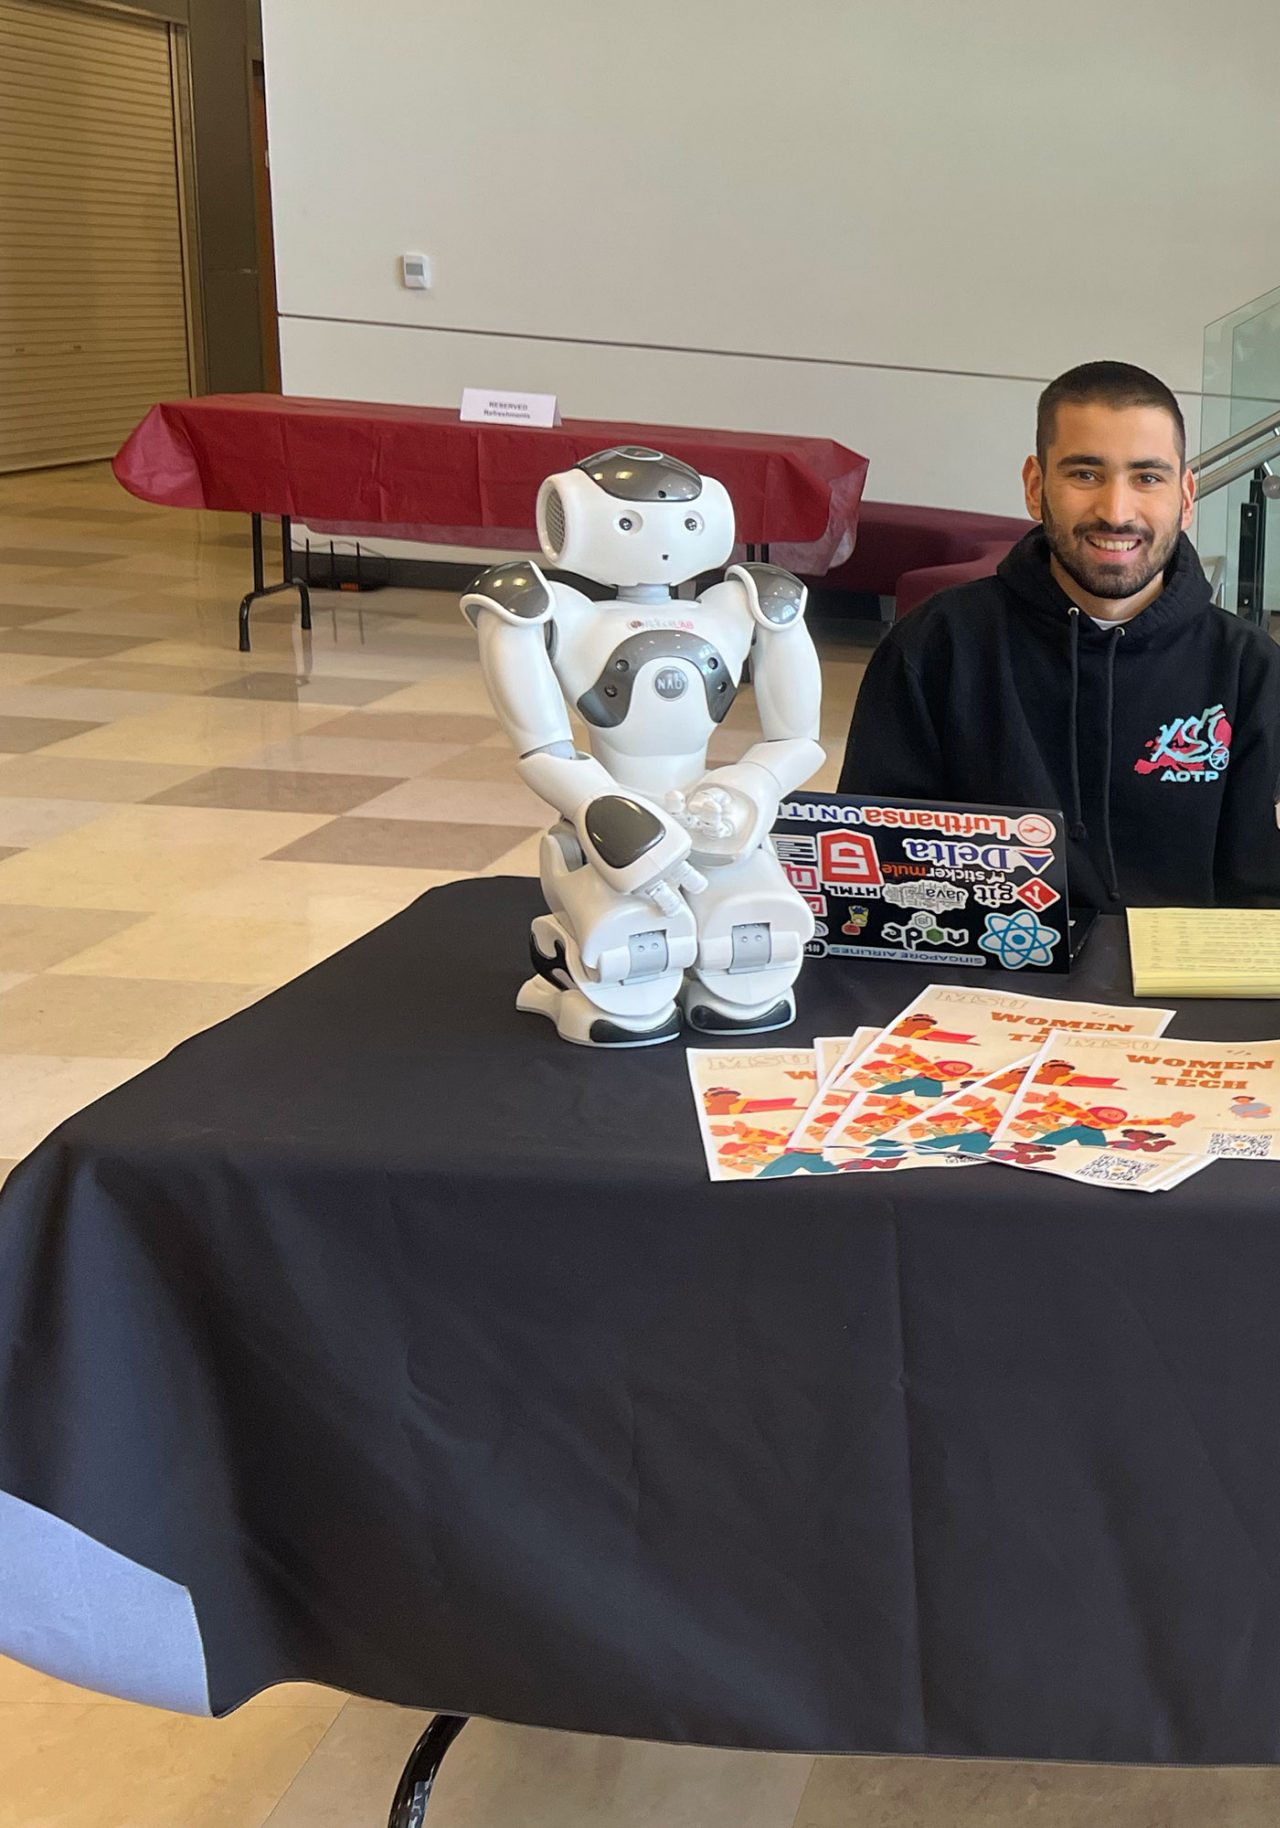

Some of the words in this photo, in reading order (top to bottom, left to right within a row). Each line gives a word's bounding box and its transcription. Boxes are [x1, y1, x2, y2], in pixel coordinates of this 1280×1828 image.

[1160, 770, 1219, 782] AOTP
[865, 809, 1006, 837] Lufthansa
[906, 841, 1009, 869] Delta
[828, 885, 879, 897] HTML
[926, 888, 966, 902] Java
[976, 885, 1014, 906] git
[831, 946, 896, 958] AIRLINES
[901, 951, 984, 965] SINGAPORE
[991, 1012, 1135, 1032] WOMEN
[1008, 1033, 1048, 1044] TE
[709, 1055, 811, 1071] MSU
[1126, 1054, 1274, 1070] WOMEN
[1181, 1070, 1224, 1079] IN
[1151, 1076, 1249, 1089] TECH
